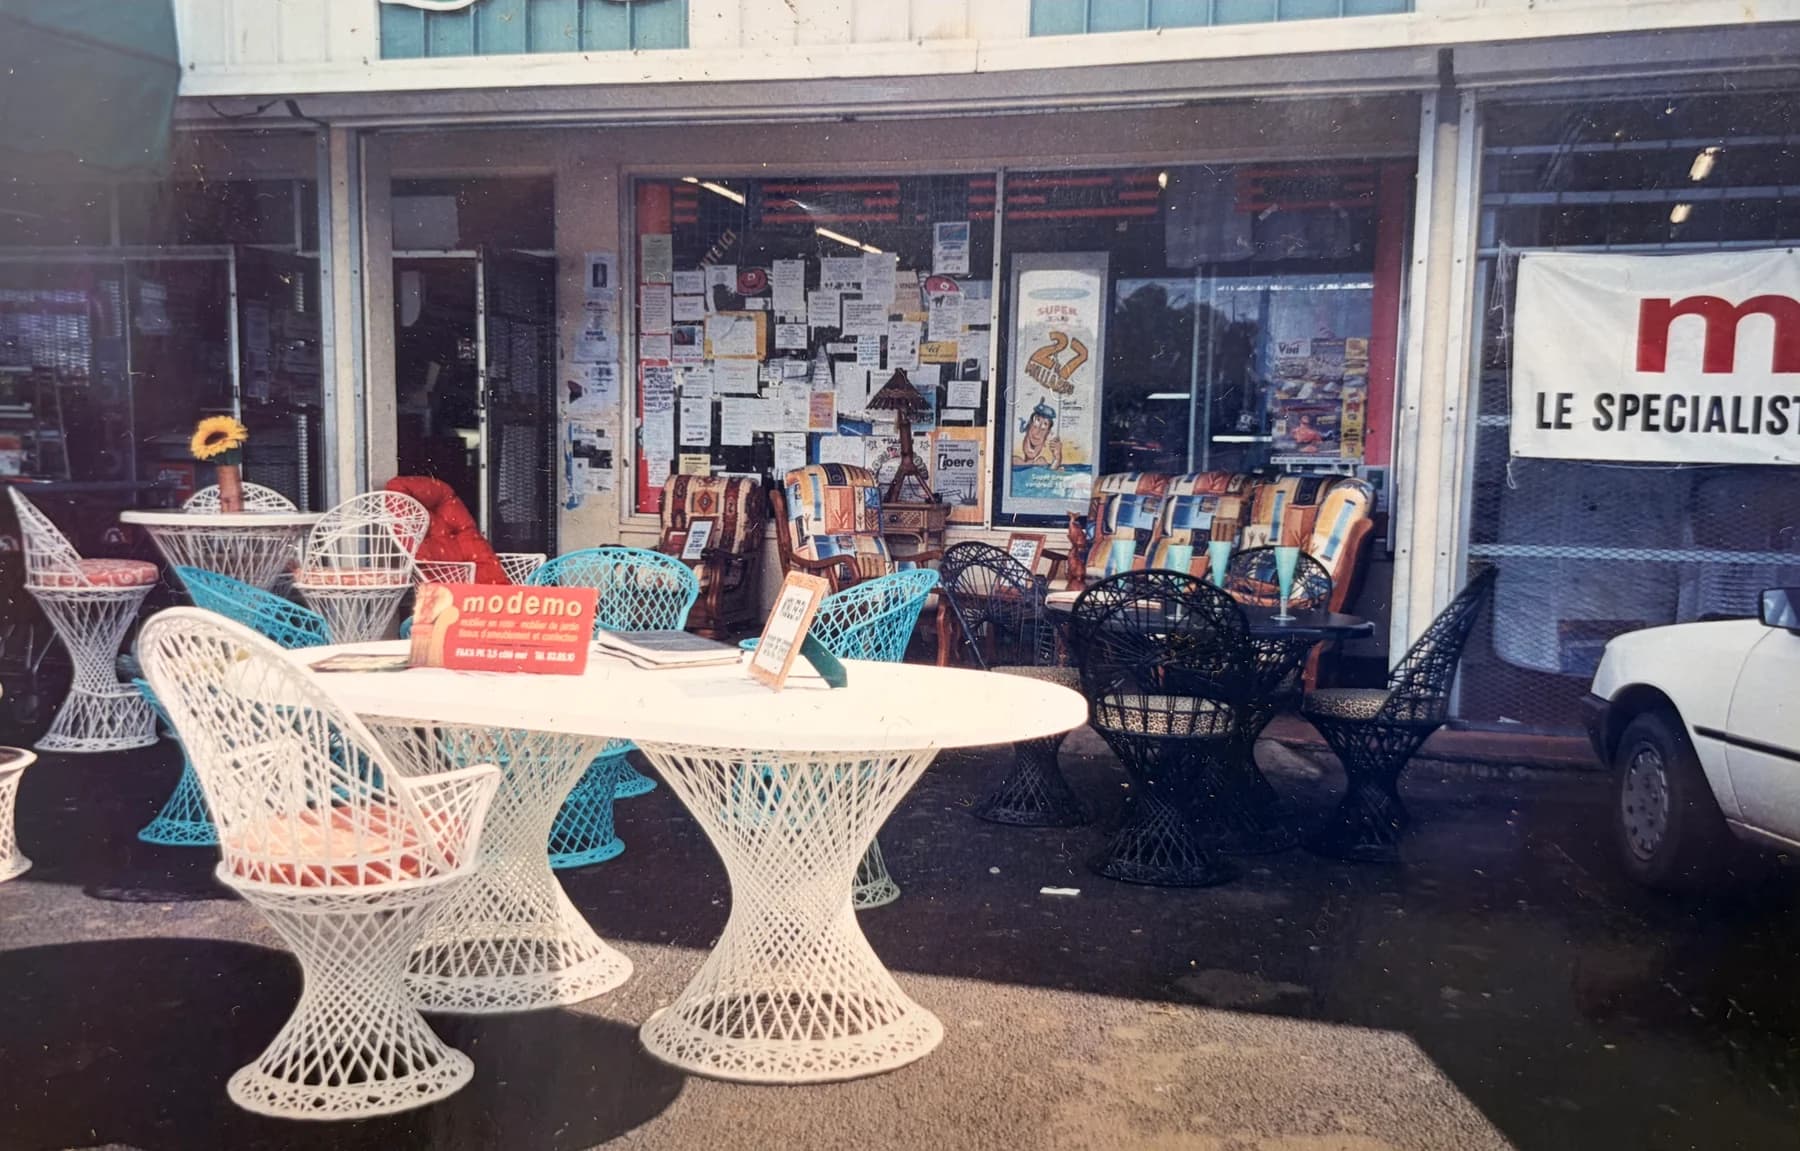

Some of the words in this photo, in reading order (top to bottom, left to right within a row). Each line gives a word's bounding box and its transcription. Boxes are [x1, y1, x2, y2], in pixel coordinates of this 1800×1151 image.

[1037, 304, 1078, 317] SUPER
[1535, 392, 1574, 430] LE
[463, 591, 583, 617] modemo
